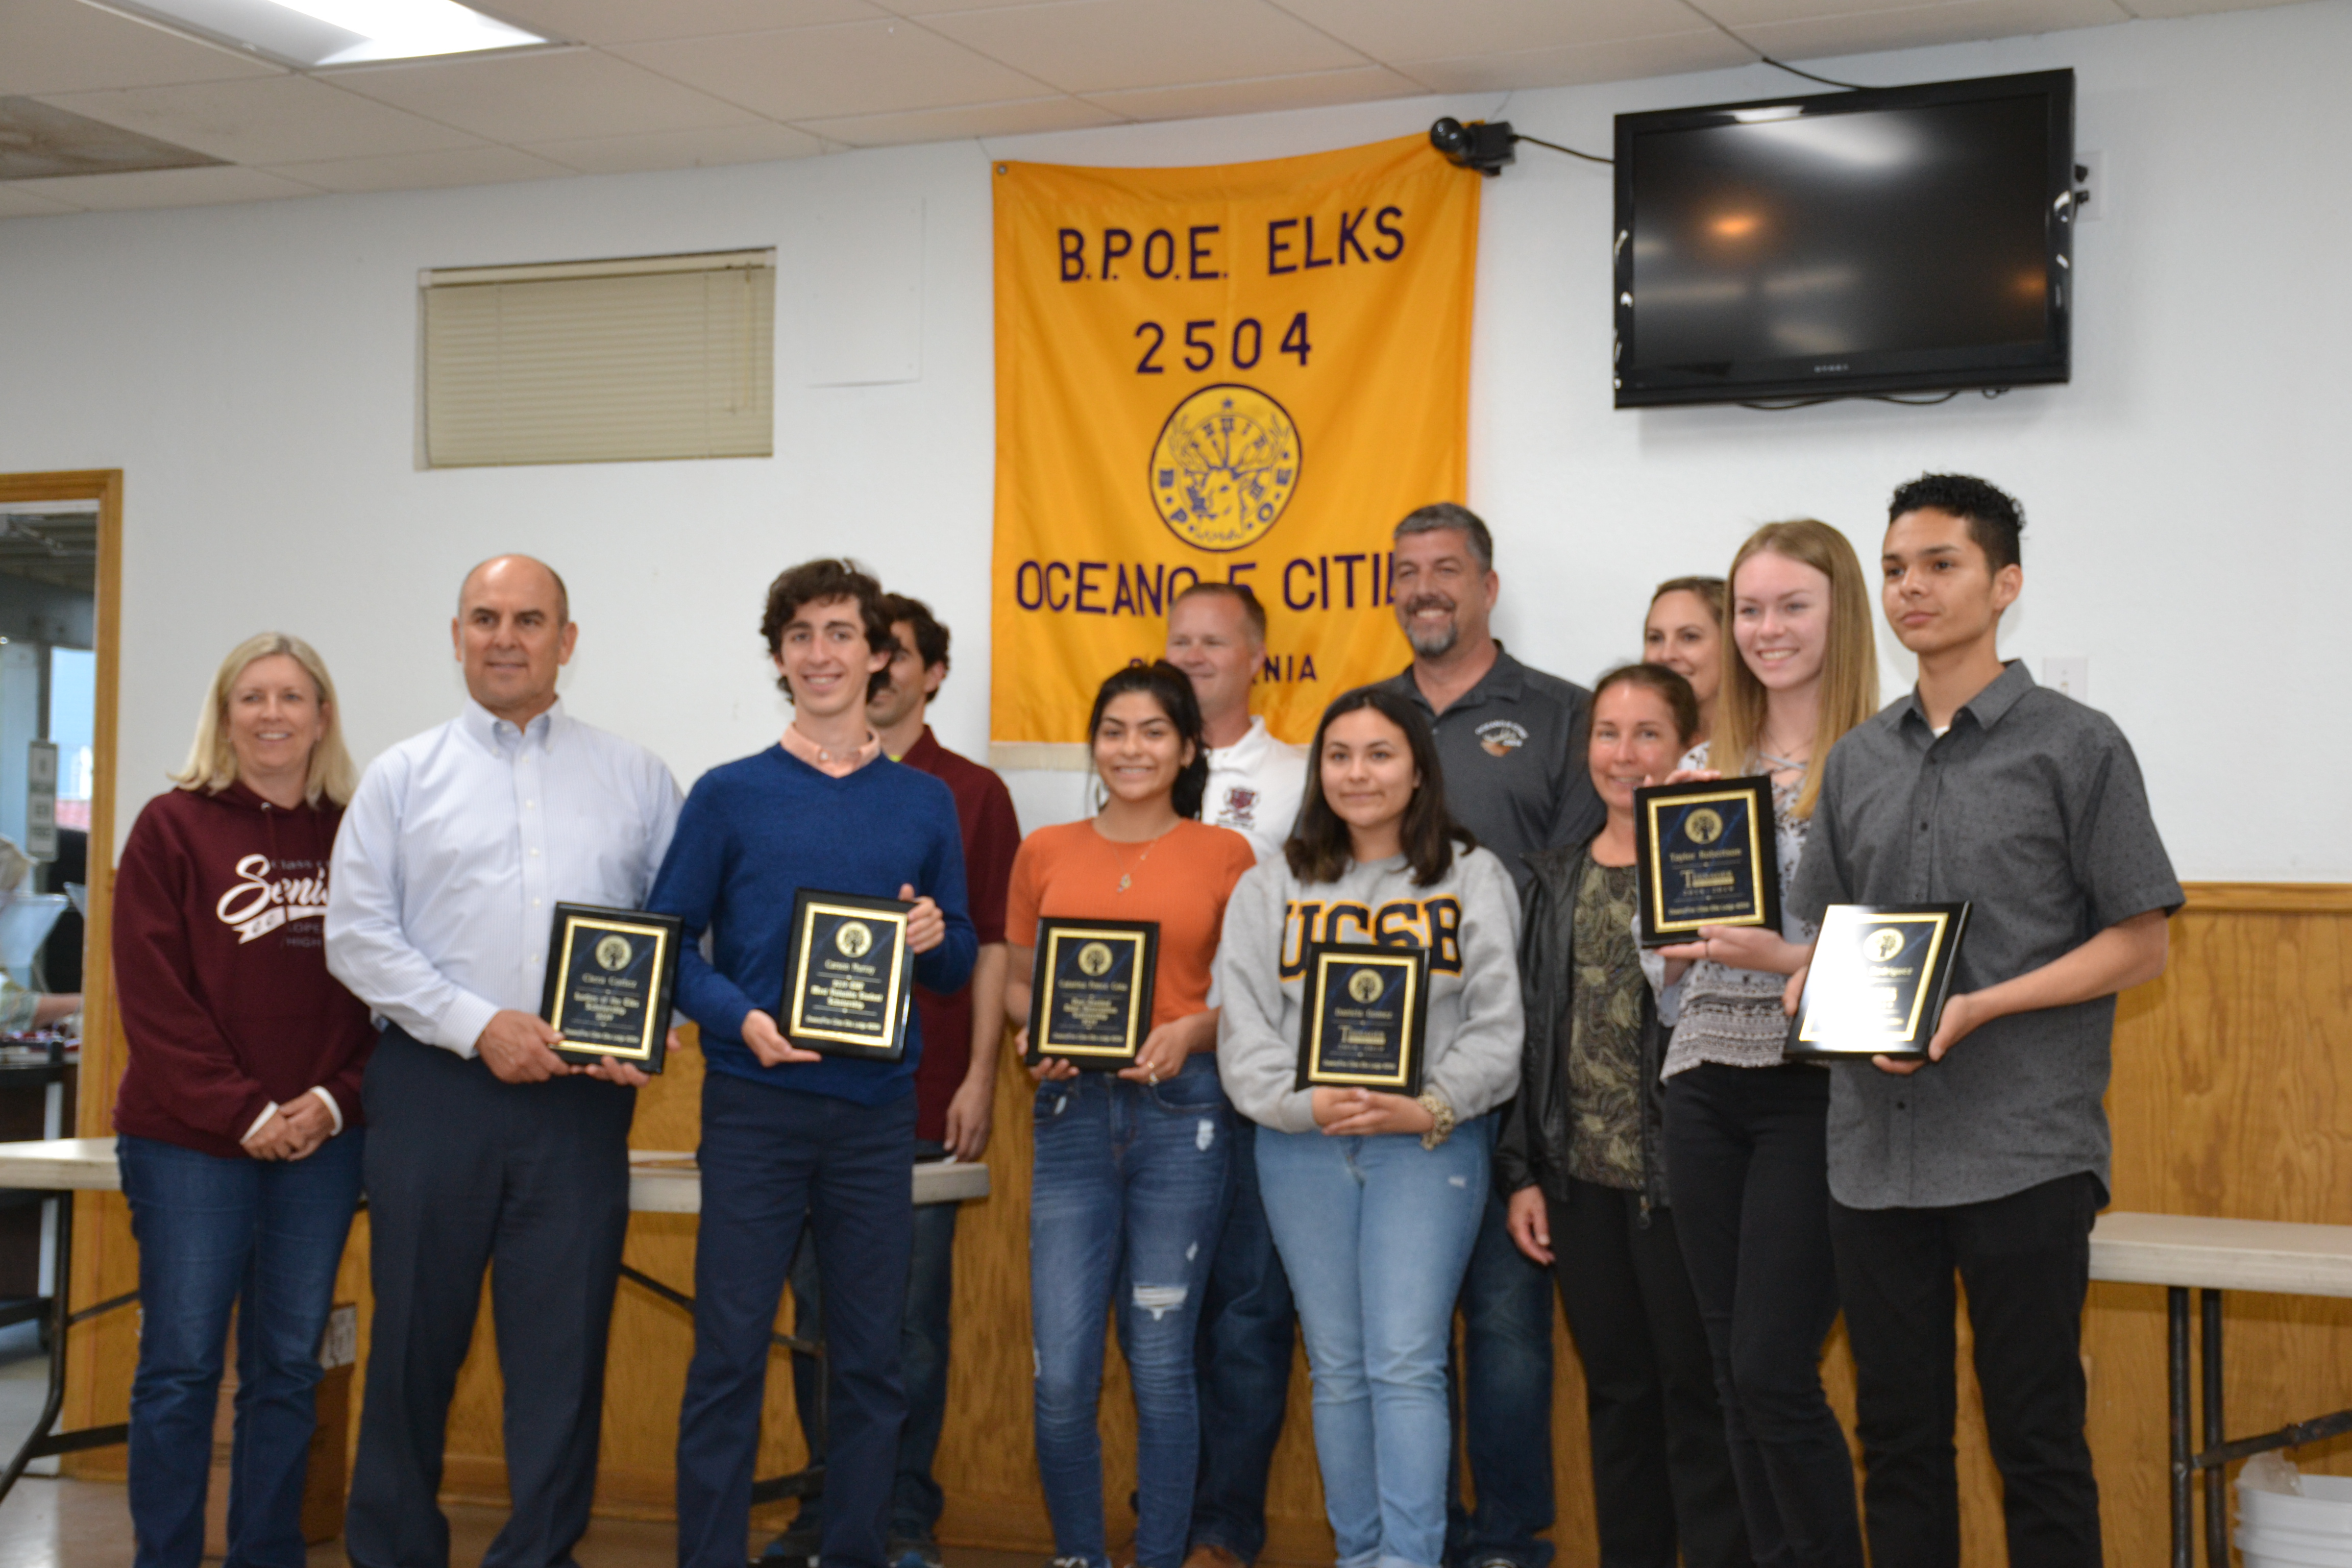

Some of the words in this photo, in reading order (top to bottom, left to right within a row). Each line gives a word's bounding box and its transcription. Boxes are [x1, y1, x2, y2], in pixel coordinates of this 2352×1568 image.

[1058, 225, 1228, 282] B.P.O.E.
[1268, 206, 1405, 277] ELKS
[1135, 311, 1311, 374] 2504
[1283, 551, 1394, 611] CITI
[216, 853, 328, 924] Seni
[1279, 893, 1463, 983] UCSB
